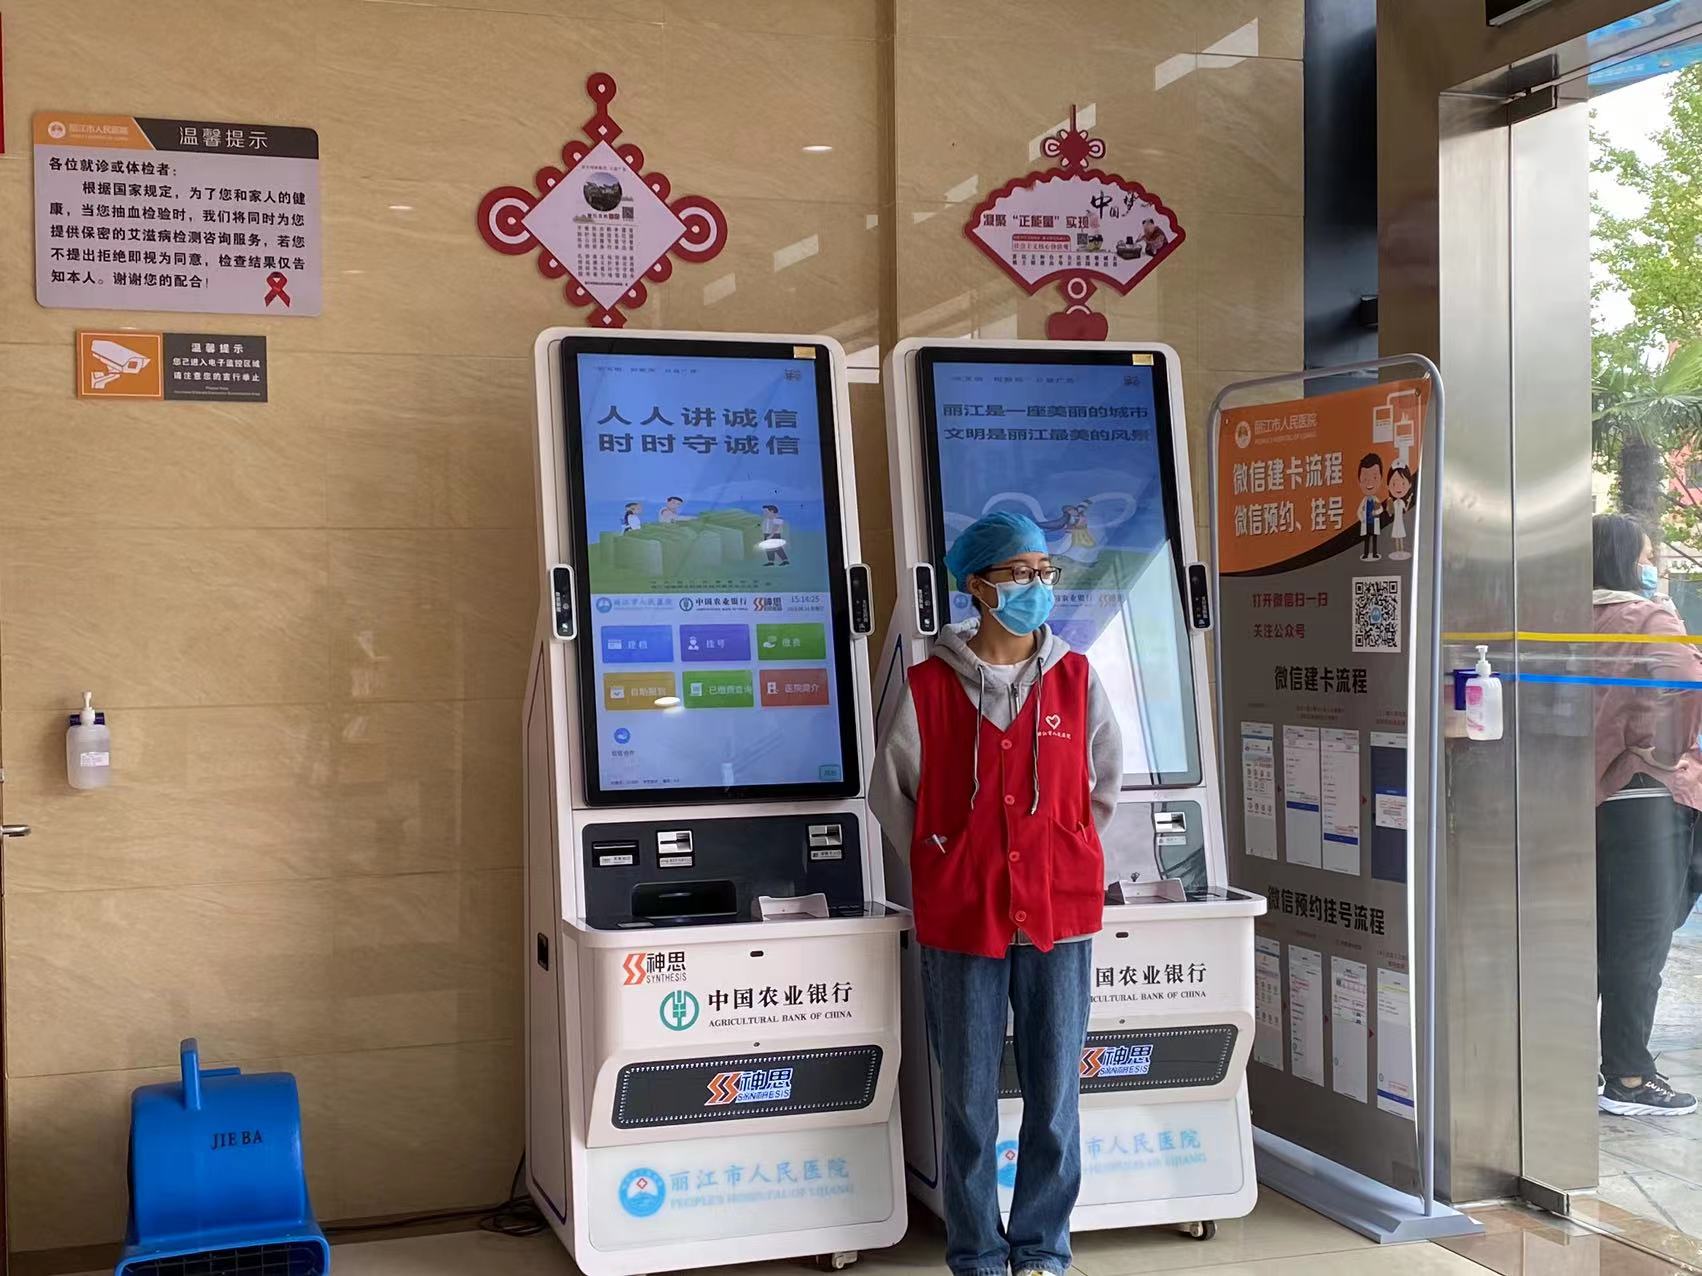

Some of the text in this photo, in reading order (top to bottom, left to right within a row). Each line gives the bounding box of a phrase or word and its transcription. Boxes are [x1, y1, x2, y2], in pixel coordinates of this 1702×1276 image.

[179, 126, 268, 149] 温馨提示
[49, 157, 177, 176] 各位就诊或体检者：
[82, 181, 306, 205] 根据国家规定，为了您和家人的健
[49, 202, 305, 226] 康，当您抽血检验时，我们将同时为您
[50, 225, 306, 249] 提供保密的艾滋病检测咨询服务，若您
[50, 248, 306, 270] 不提出拒绝即视为同意，检查结果仅告
[51, 269, 209, 289] 知本人。谢谢您的配合！
[191, 342, 243, 354] 温馨提示
[597, 405, 799, 429] 人人讲诚信
[943, 404, 1148, 418] 丽江是一座美丽的城市
[944, 428, 1151, 442] 文明是丽江最美的风景
[1254, 413, 1318, 435] 丽江市人民医院
[598, 432, 800, 455] 时时守诚信
[1233, 451, 1344, 495] 微信建卡流程
[1234, 496, 1344, 537] 微信预约、挂号
[1252, 592, 1328, 609] 打开微信扫一扫
[1253, 623, 1305, 639] 关注公众号
[1274, 665, 1368, 694] 微信建卡流程
[1267, 886, 1385, 936] 微信预约挂号流程
[646, 951, 687, 972] 神思
[646, 972, 687, 984] SYNTHESIS
[708, 981, 853, 1012] 中国农业银行
[1141, 992, 1164, 1000] BANK
[1167, 991, 1178, 999] OF
[1181, 990, 1207, 998] CHINA
[709, 1010, 853, 1027] AGRICULTURAL BANK OF CHINA
[1103, 1044, 1153, 1066] 神思
[739, 1068, 794, 1090] 神思
[737, 1089, 791, 1102] SYNTHESIS
[669, 1158, 850, 1192] 丽江市人民医院
